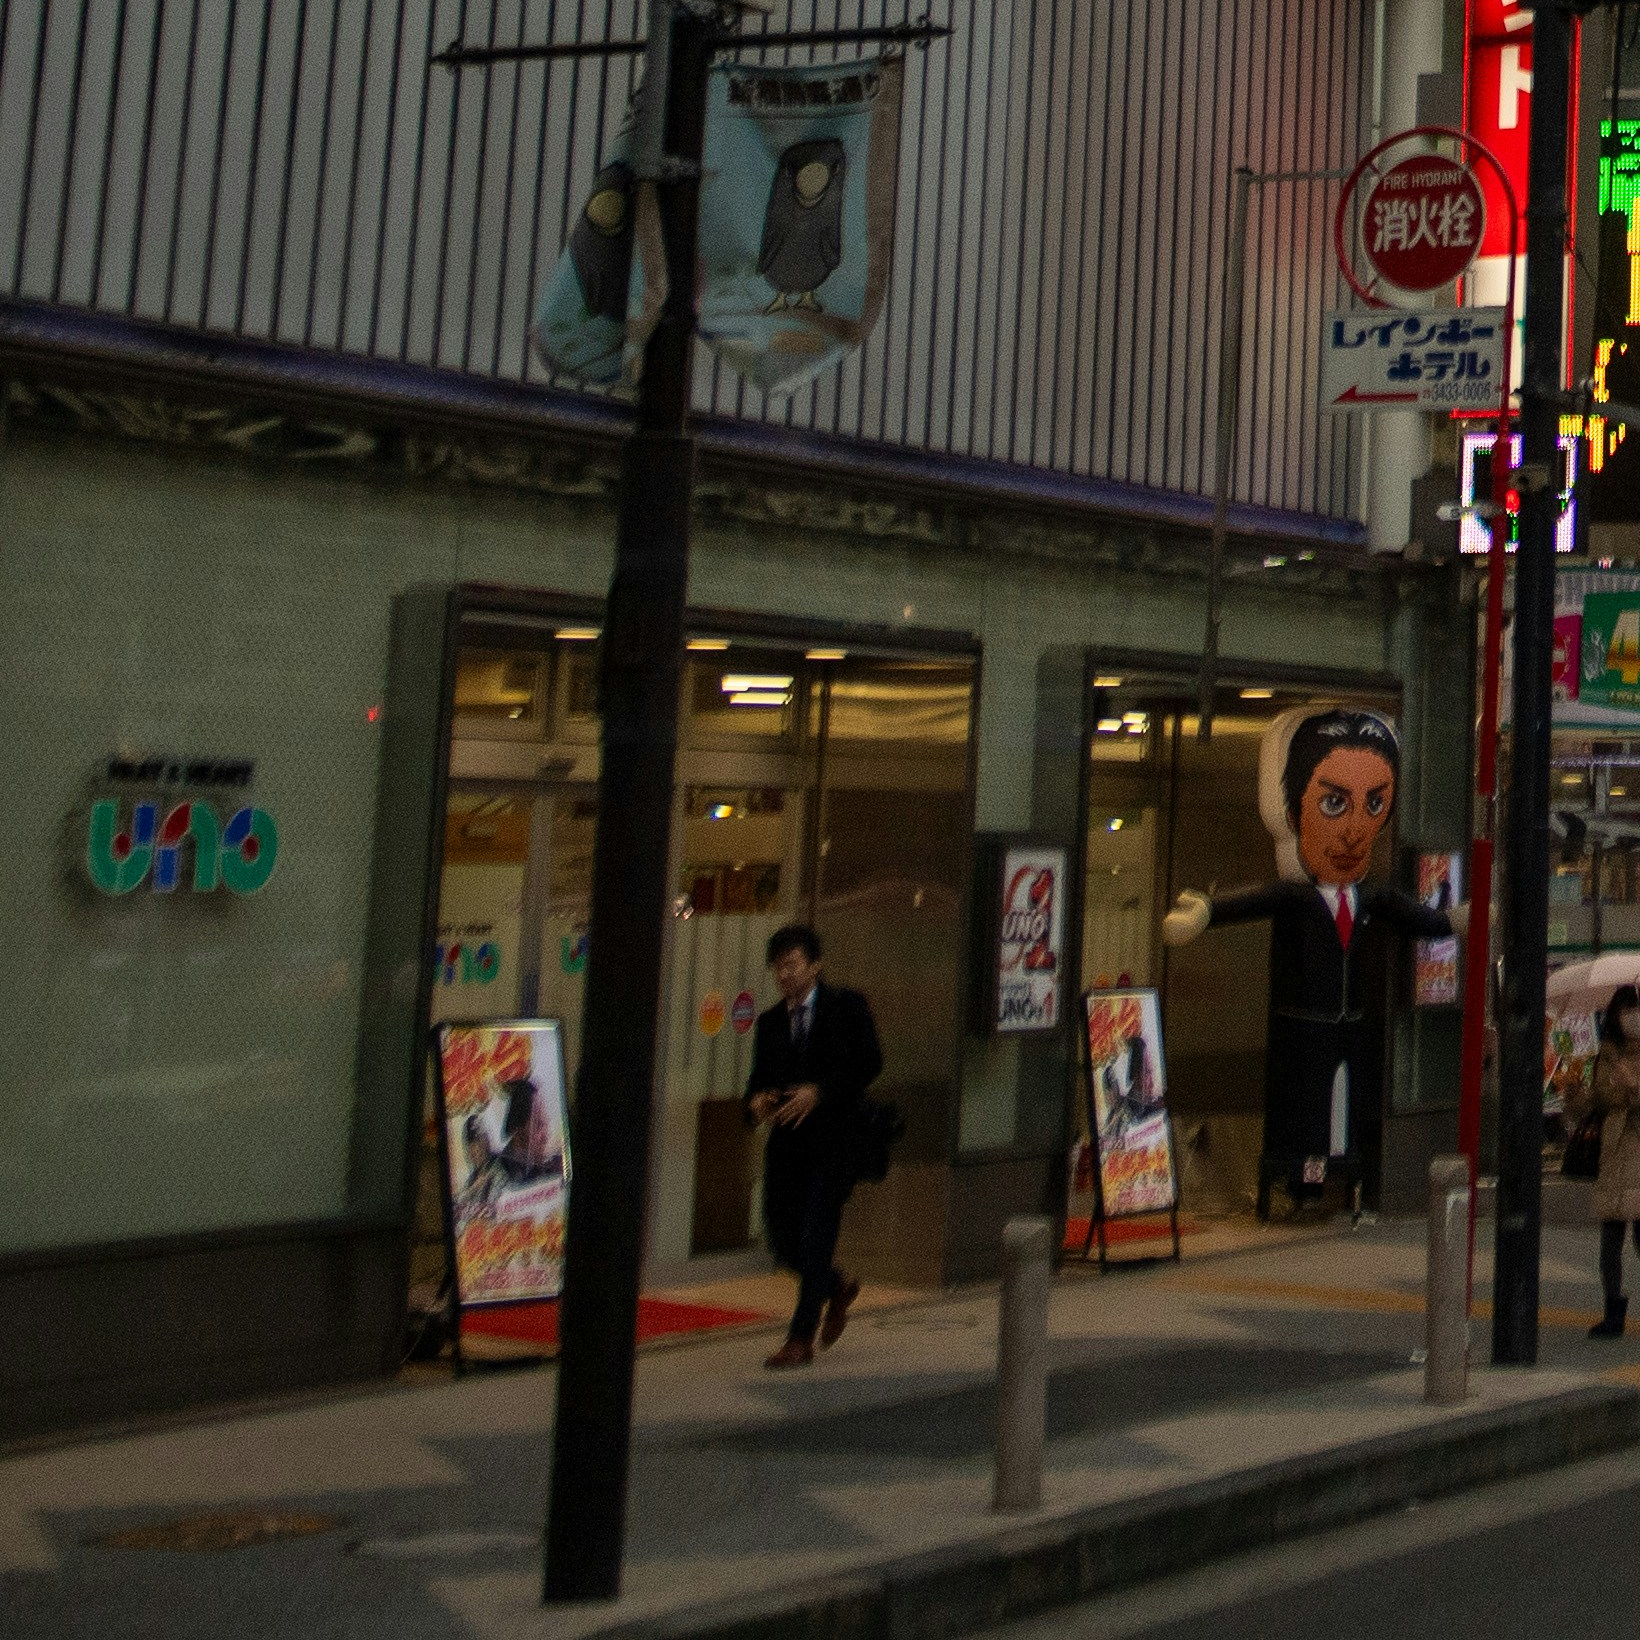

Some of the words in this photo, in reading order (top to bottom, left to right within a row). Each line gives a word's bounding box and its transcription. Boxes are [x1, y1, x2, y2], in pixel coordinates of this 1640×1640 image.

[1383, 173, 1409, 191] FIRE
[1412, 169, 1464, 188] HYDRANT
[1373, 192, 1477, 253] 消火栓
[1332, 316, 1494, 349] レインボー
[1387, 352, 1491, 382] ホテル
